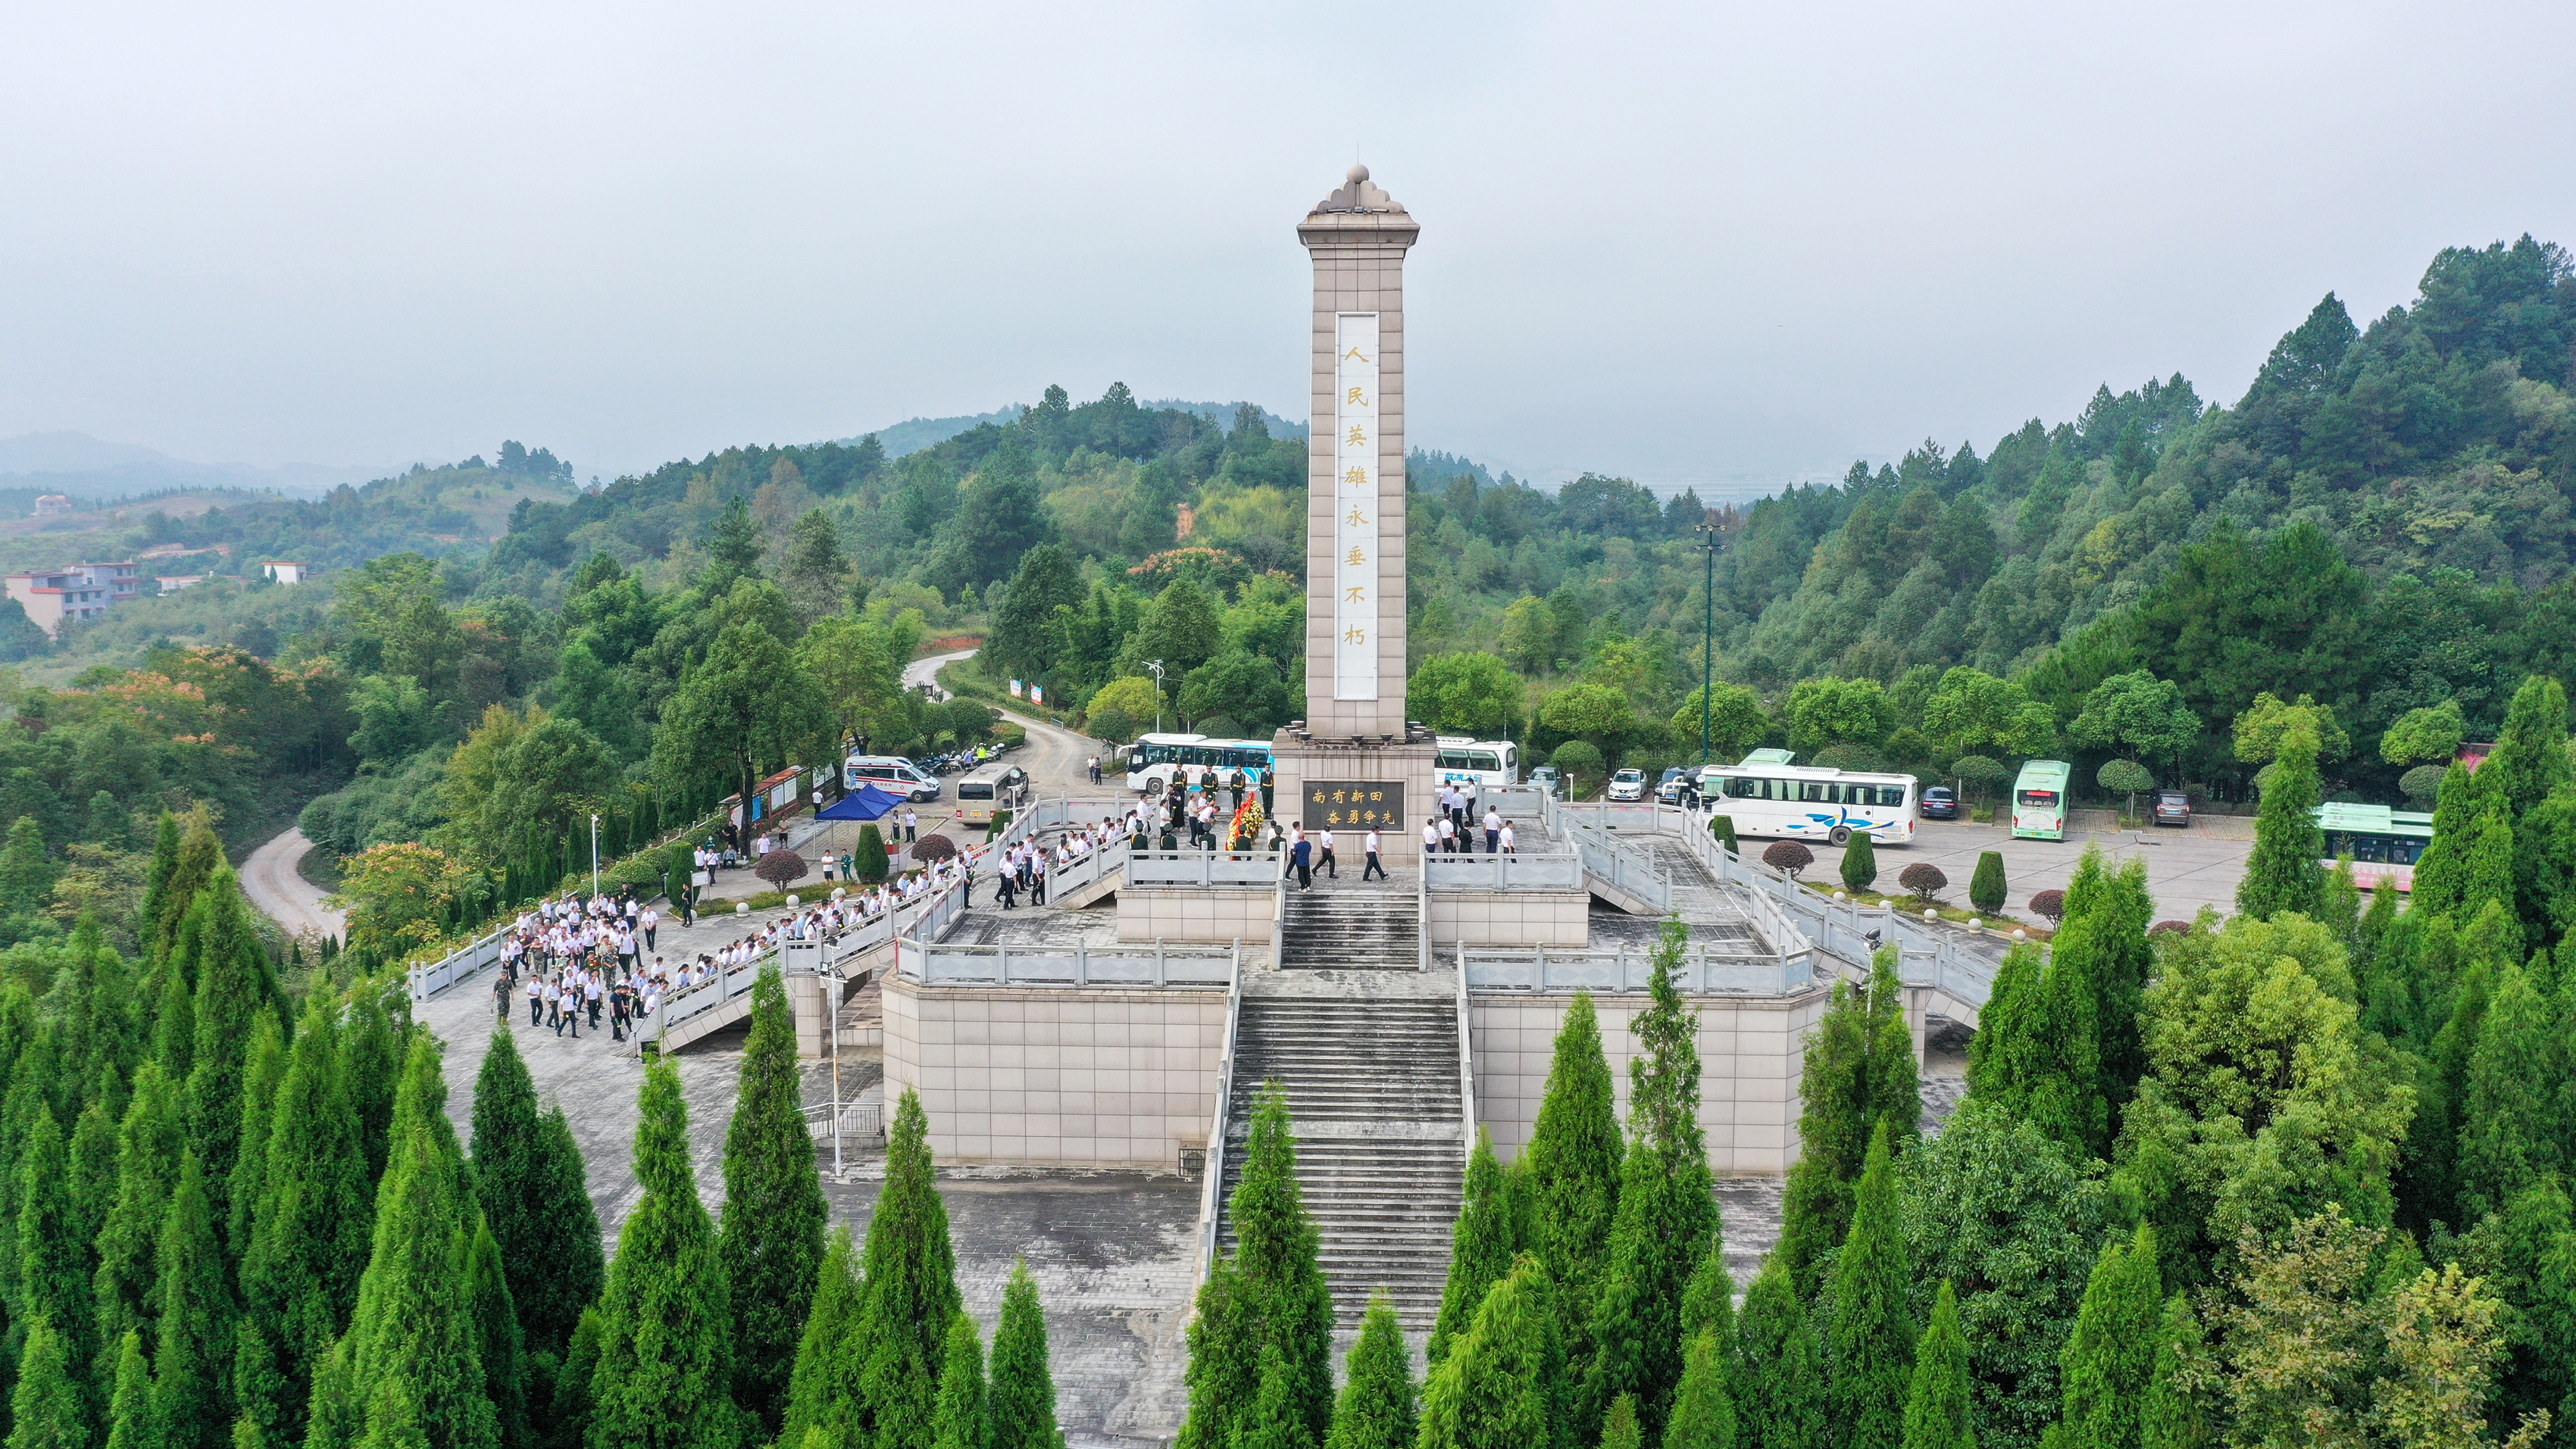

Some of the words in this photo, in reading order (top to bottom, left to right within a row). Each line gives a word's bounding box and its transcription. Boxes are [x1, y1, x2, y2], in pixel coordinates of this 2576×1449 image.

[1344, 347, 1370, 646] 人民英雄永垂不朽
[1312, 789, 1383, 804] 南有新田
[1327, 810, 1396, 824] 奋勇争先
